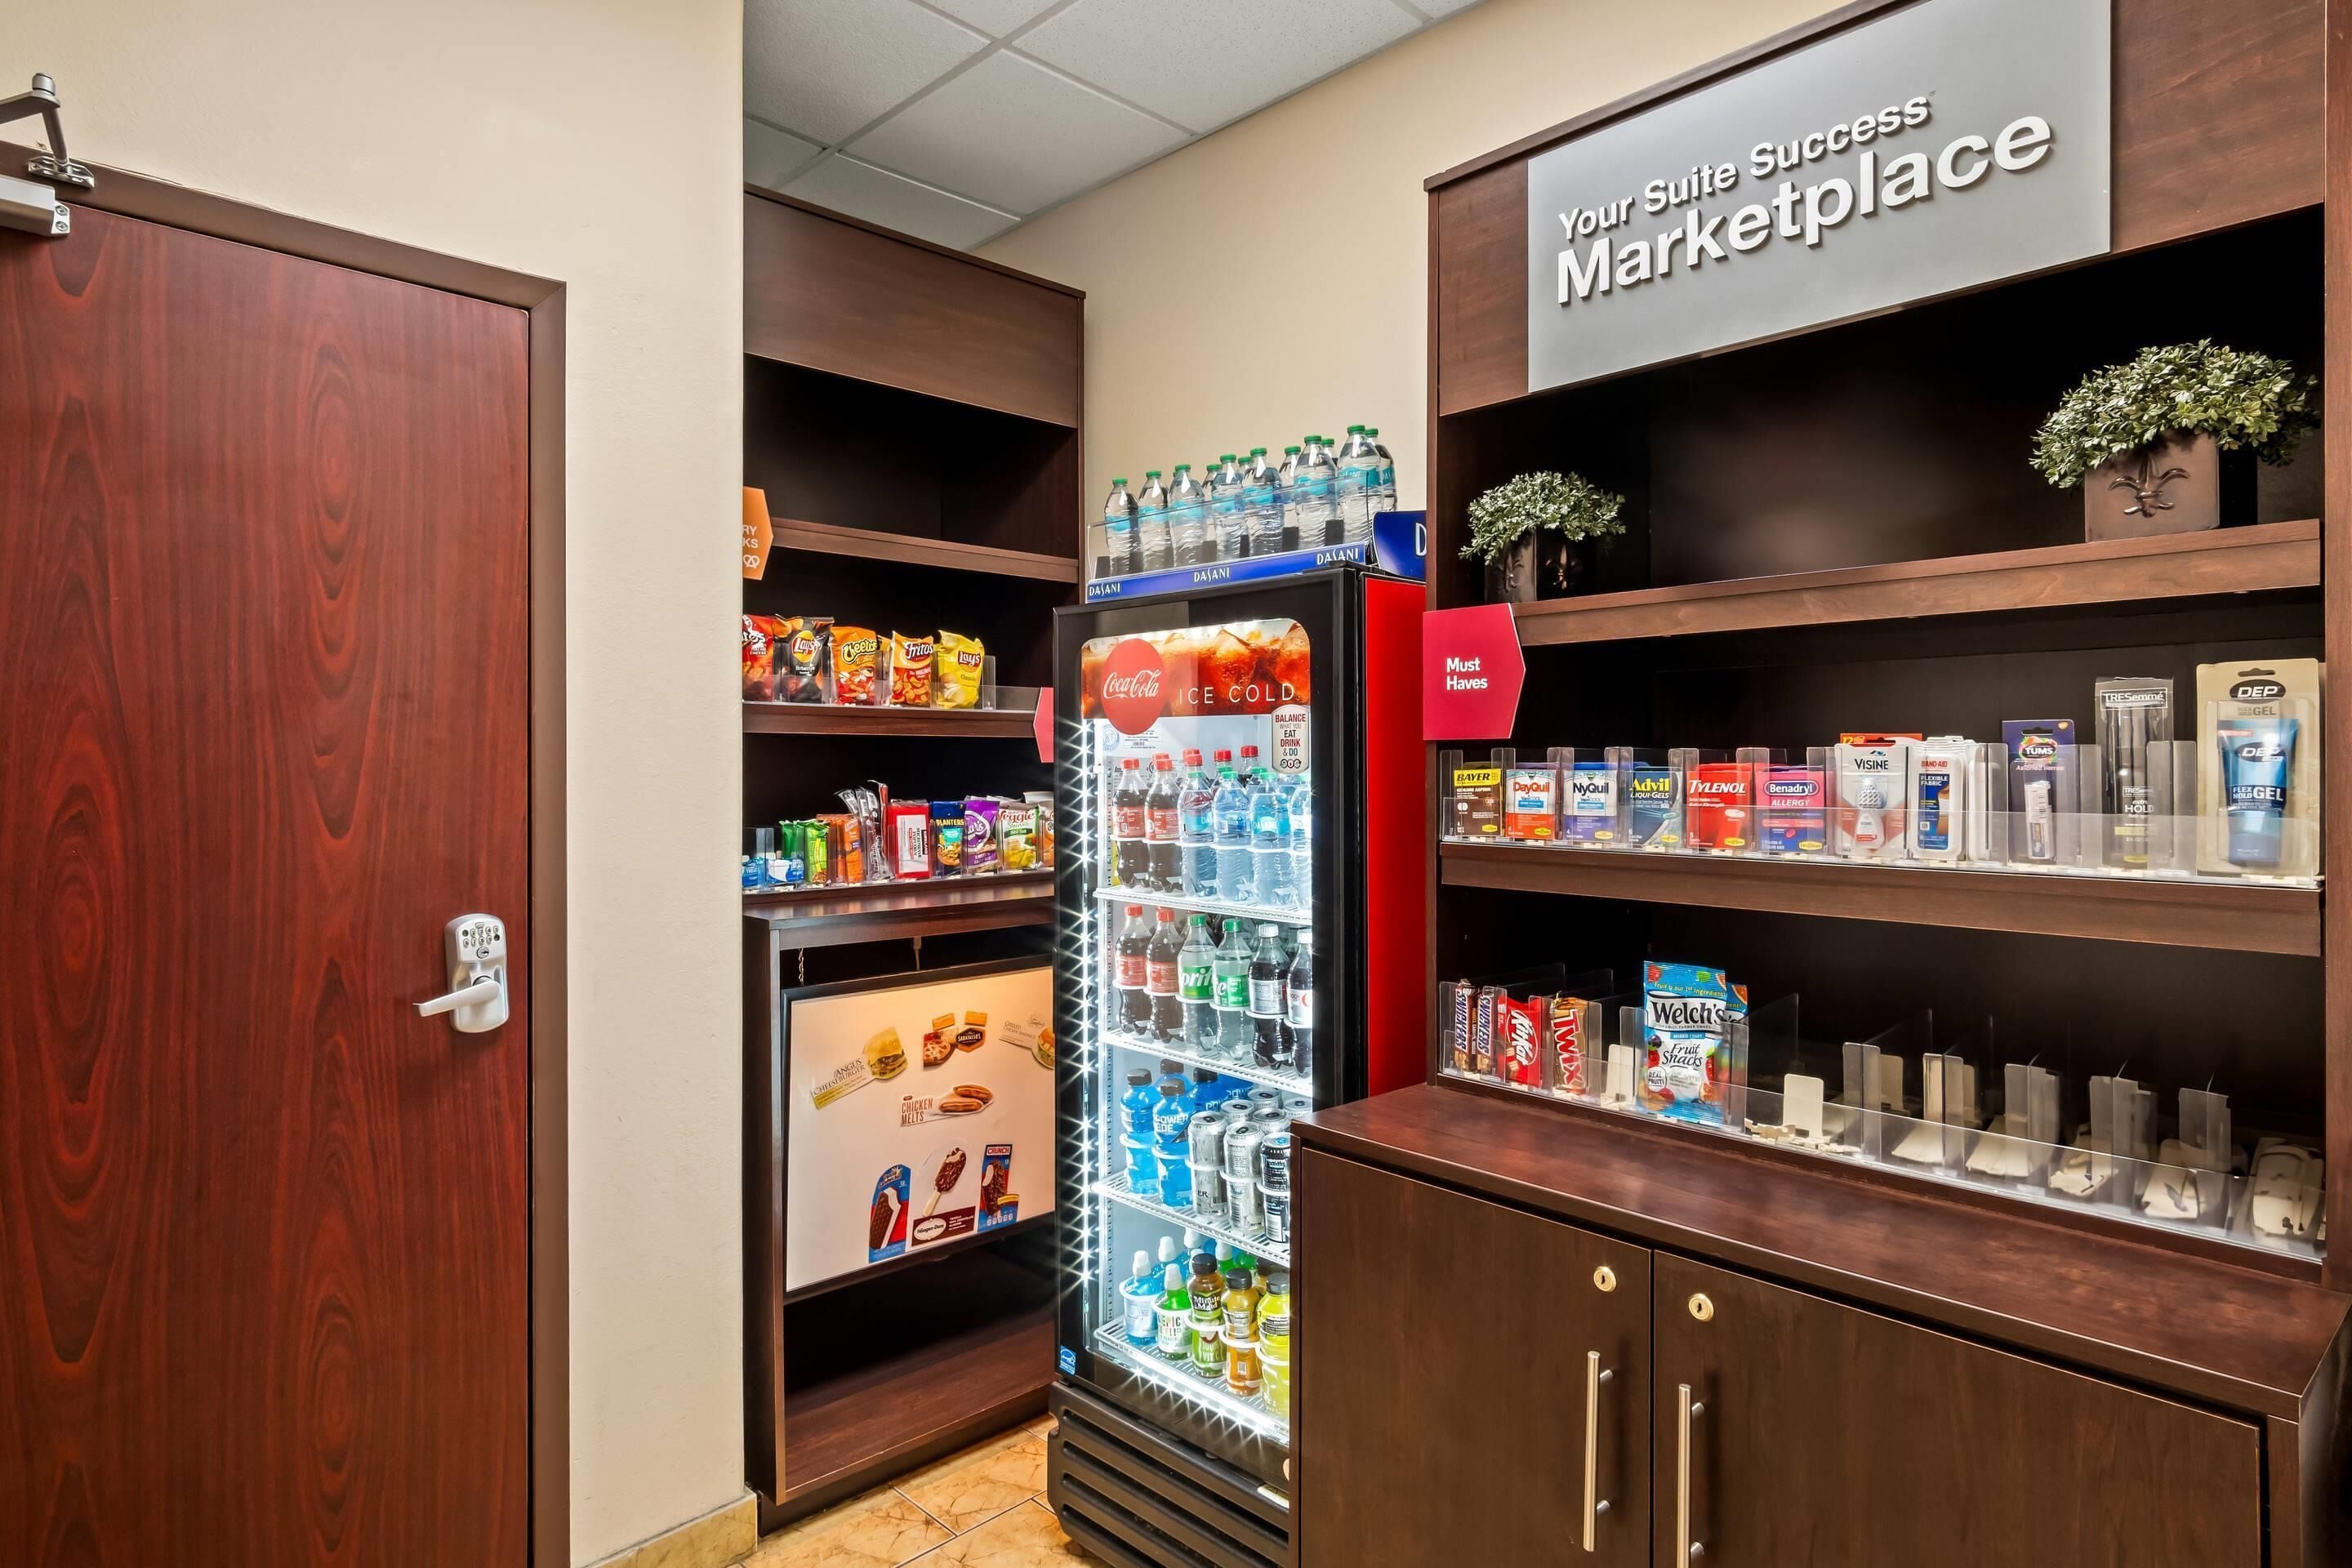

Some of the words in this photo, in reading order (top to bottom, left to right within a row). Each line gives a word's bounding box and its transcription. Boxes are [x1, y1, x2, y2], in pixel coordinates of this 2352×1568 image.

[1557, 196, 1634, 242] Your
[1643, 163, 1738, 215] Suite
[1749, 95, 1930, 179] Success
[1557, 114, 2053, 305] Marketplace
[743, 524, 757, 536] RY
[743, 537, 758, 549] KS
[1316, 547, 1360, 565] DASANI
[1194, 567, 1231, 582] DASANI
[1089, 581, 1121, 597] DASANI
[842, 639, 878, 665] Cheetos
[906, 643, 933, 659] Fritos
[959, 652, 980, 666] Lay's
[1446, 657, 1481, 673] Must
[1446, 675, 1488, 690] Haves
[1178, 687, 1214, 705] ICE
[1228, 683, 1295, 702] COLD
[2104, 692, 2164, 702] TRESemmé
[2237, 685, 2278, 698] DEP
[2252, 706, 2277, 716] GEL
[1275, 714, 1306, 723] BALANCE
[1284, 729, 1297, 737] EAT
[1281, 738, 1301, 747] DRINK
[1289, 748, 1298, 756] DO
[2025, 747, 2053, 755] TUMS
[2242, 746, 2281, 757] DEP
[1854, 759, 1888, 770] VISINE
[1457, 773, 1490, 782] BAYER
[1629, 778, 1670, 791] Advil
[1513, 782, 1550, 794] DayQuil
[1573, 782, 1609, 796] NyQuil
[1689, 780, 1746, 794] TYLENOL
[1770, 782, 1813, 795] Benadryl
[2252, 786, 2284, 801] GEL
[2125, 804, 2154, 813] HOLD
[997, 809, 1035, 823] Veggie
[1650, 1000, 1725, 1025] Welch's
[1455, 990, 1468, 1054] SNICKERS
[1477, 995, 1491, 1057] SNICKERS
[1552, 1009, 1584, 1088] TWIX
[1671, 1043, 1700, 1054] Fruit
[1662, 1050, 1703, 1068] Snacks
[813, 1064, 866, 1095] CHEESEBURGER
[902, 1098, 933, 1114] CHICKEN
[901, 1111, 924, 1125] MELTS
[1193, 1294, 1221, 1305] Minute
